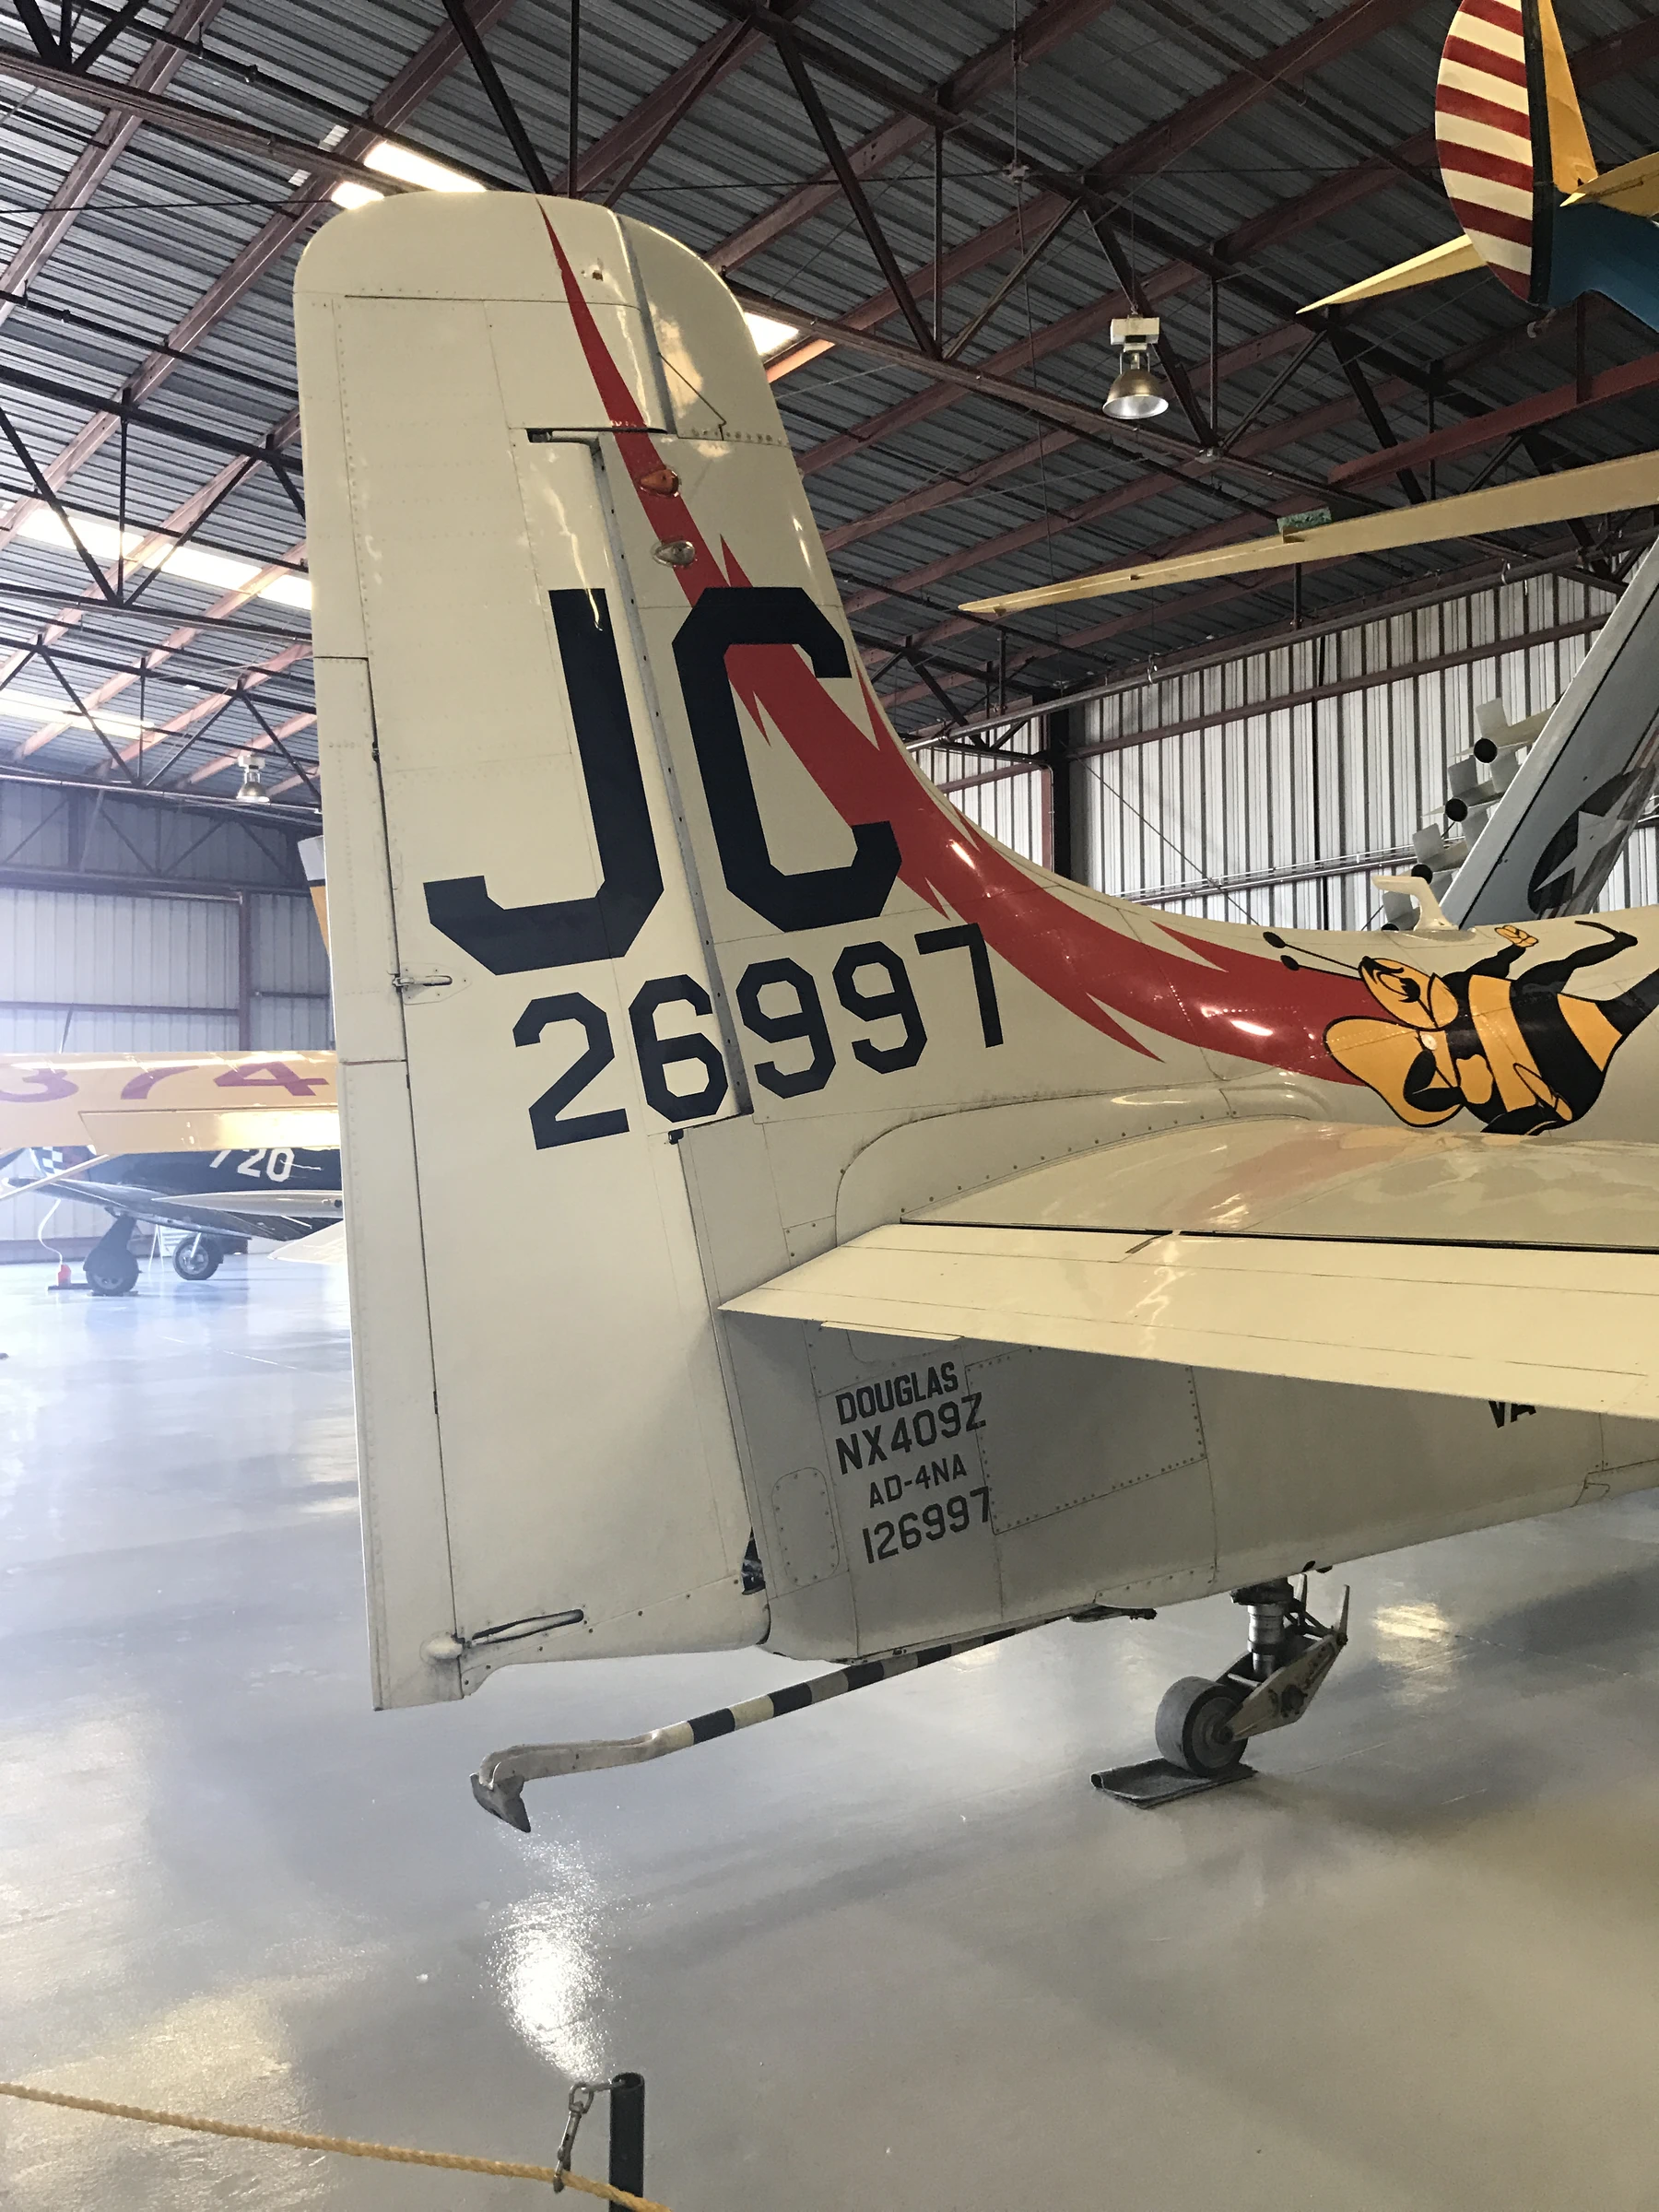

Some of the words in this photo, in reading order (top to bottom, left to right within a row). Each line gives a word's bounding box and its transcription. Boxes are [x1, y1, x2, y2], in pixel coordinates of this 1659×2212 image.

[423, 587, 902, 975] JC
[512, 923, 1005, 1150] 26997
[835, 1361, 959, 1426] DOUGLAS
[836, 1392, 987, 1476] NX409Z
[869, 1453, 968, 1509] AD-4NA
[863, 1486, 990, 1564] 126997
